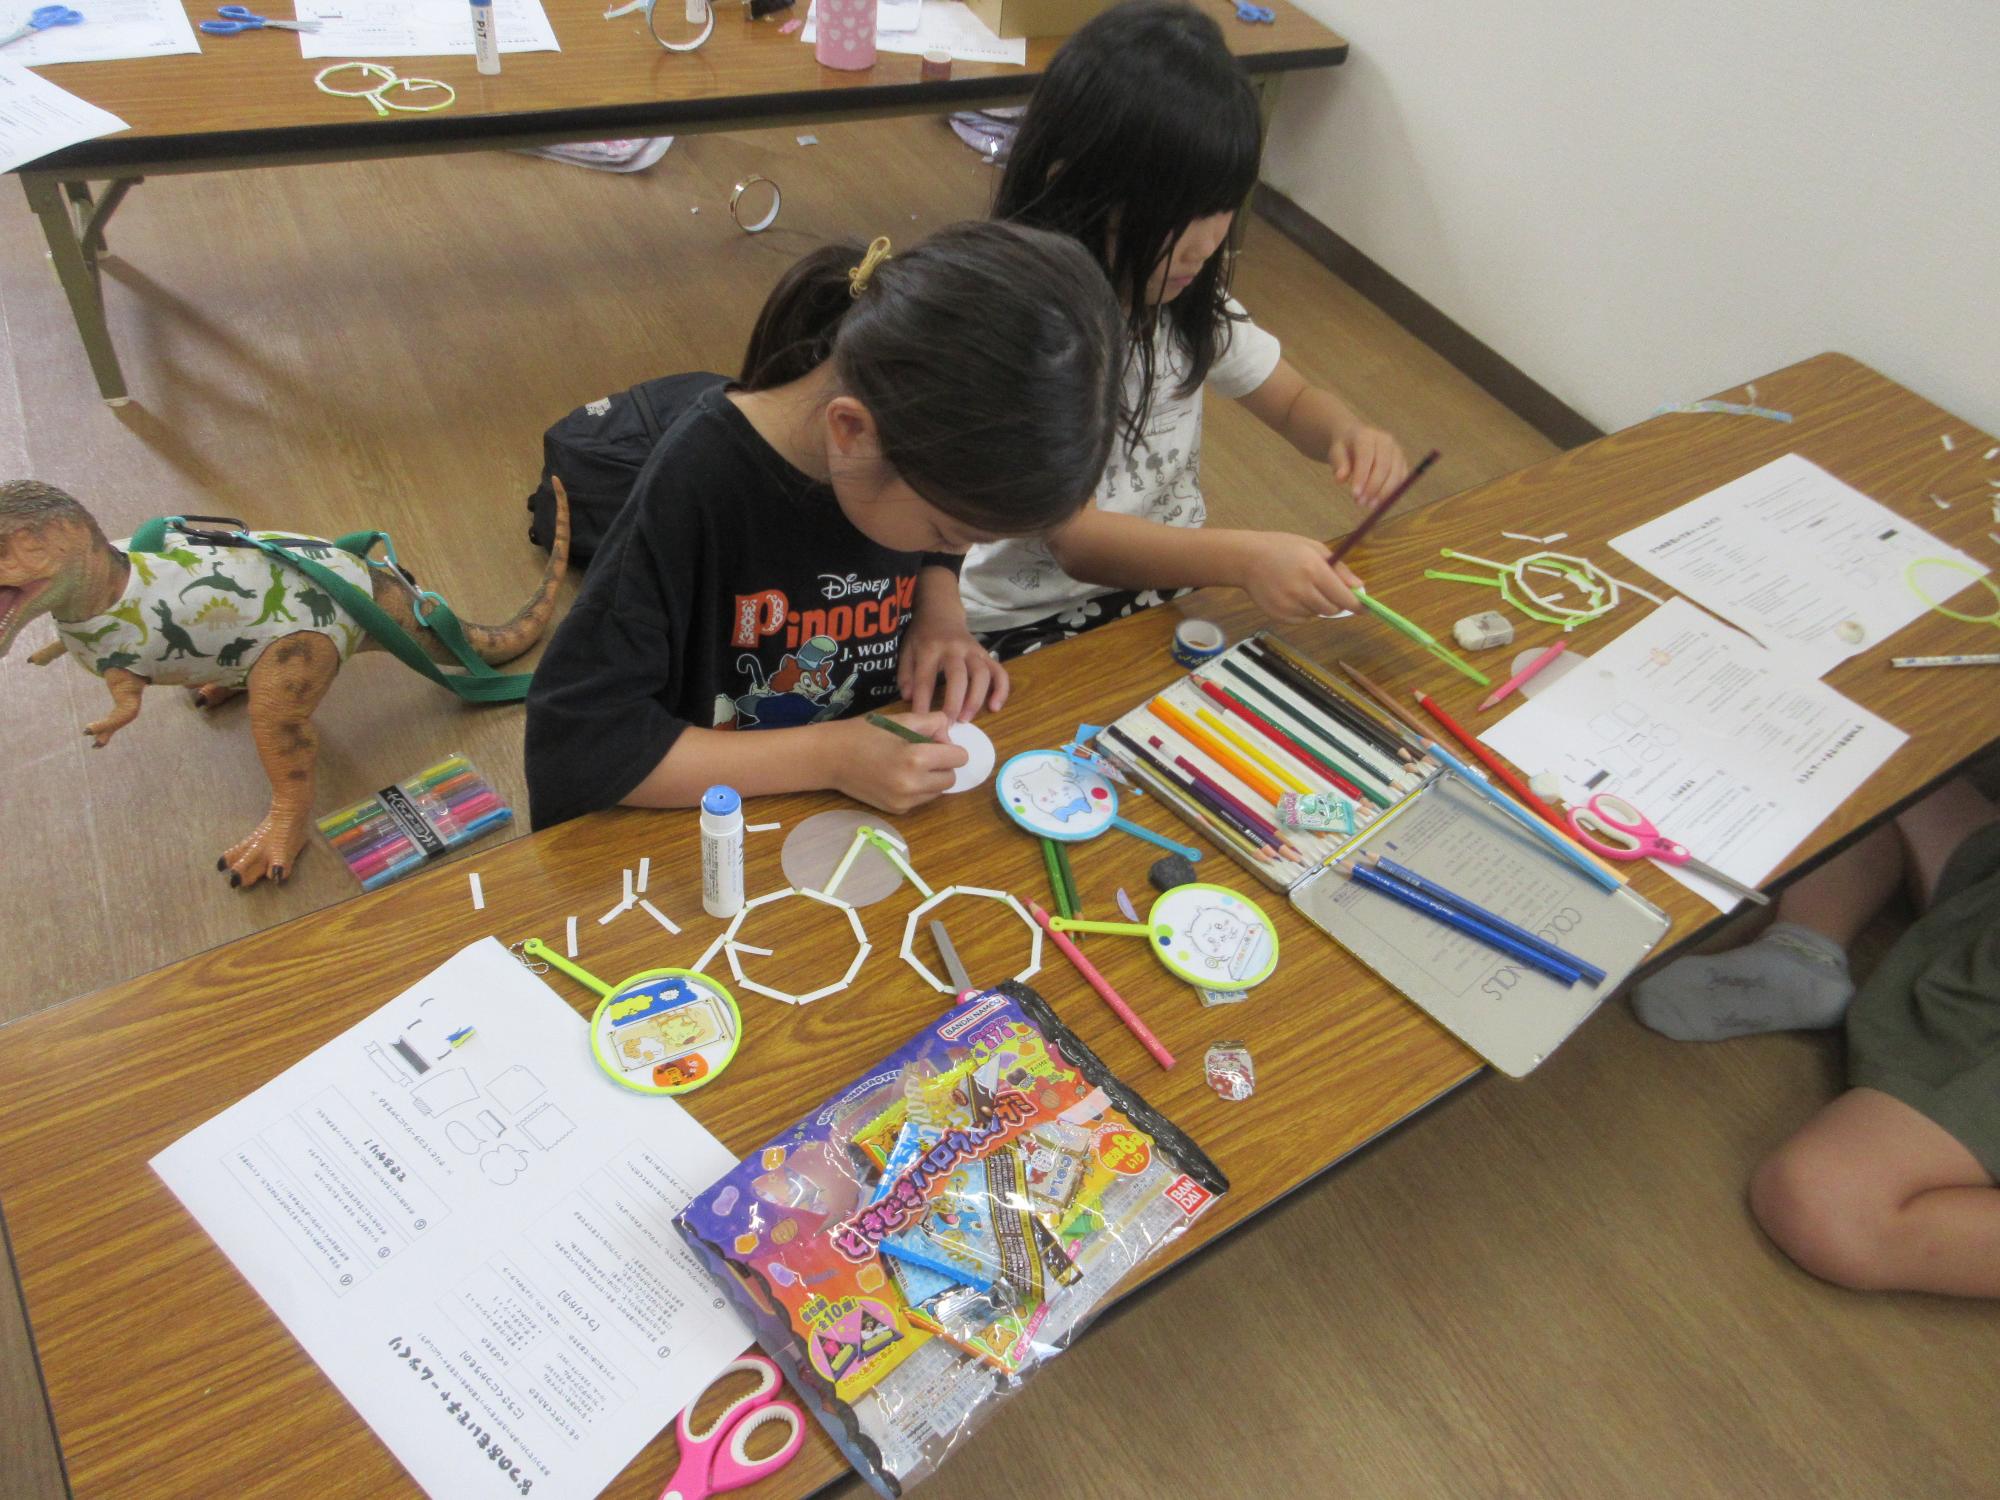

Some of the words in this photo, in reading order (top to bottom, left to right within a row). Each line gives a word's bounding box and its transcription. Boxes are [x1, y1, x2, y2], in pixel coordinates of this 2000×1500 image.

[731, 575, 917, 648] Pinocc
[840, 647, 854, 663] J.
[858, 637, 899, 659] WOR
[853, 657, 899, 673] FOUL
[944, 1014, 975, 1037] BANDAI
[971, 995, 1002, 1019] NAMCO
[1047, 1154, 1073, 1194] COLA
[1170, 1179, 1195, 1200] BAN
[1181, 1189, 1202, 1209] DAI
[387, 1333, 535, 1497] なつのおもいでチャームづくり
